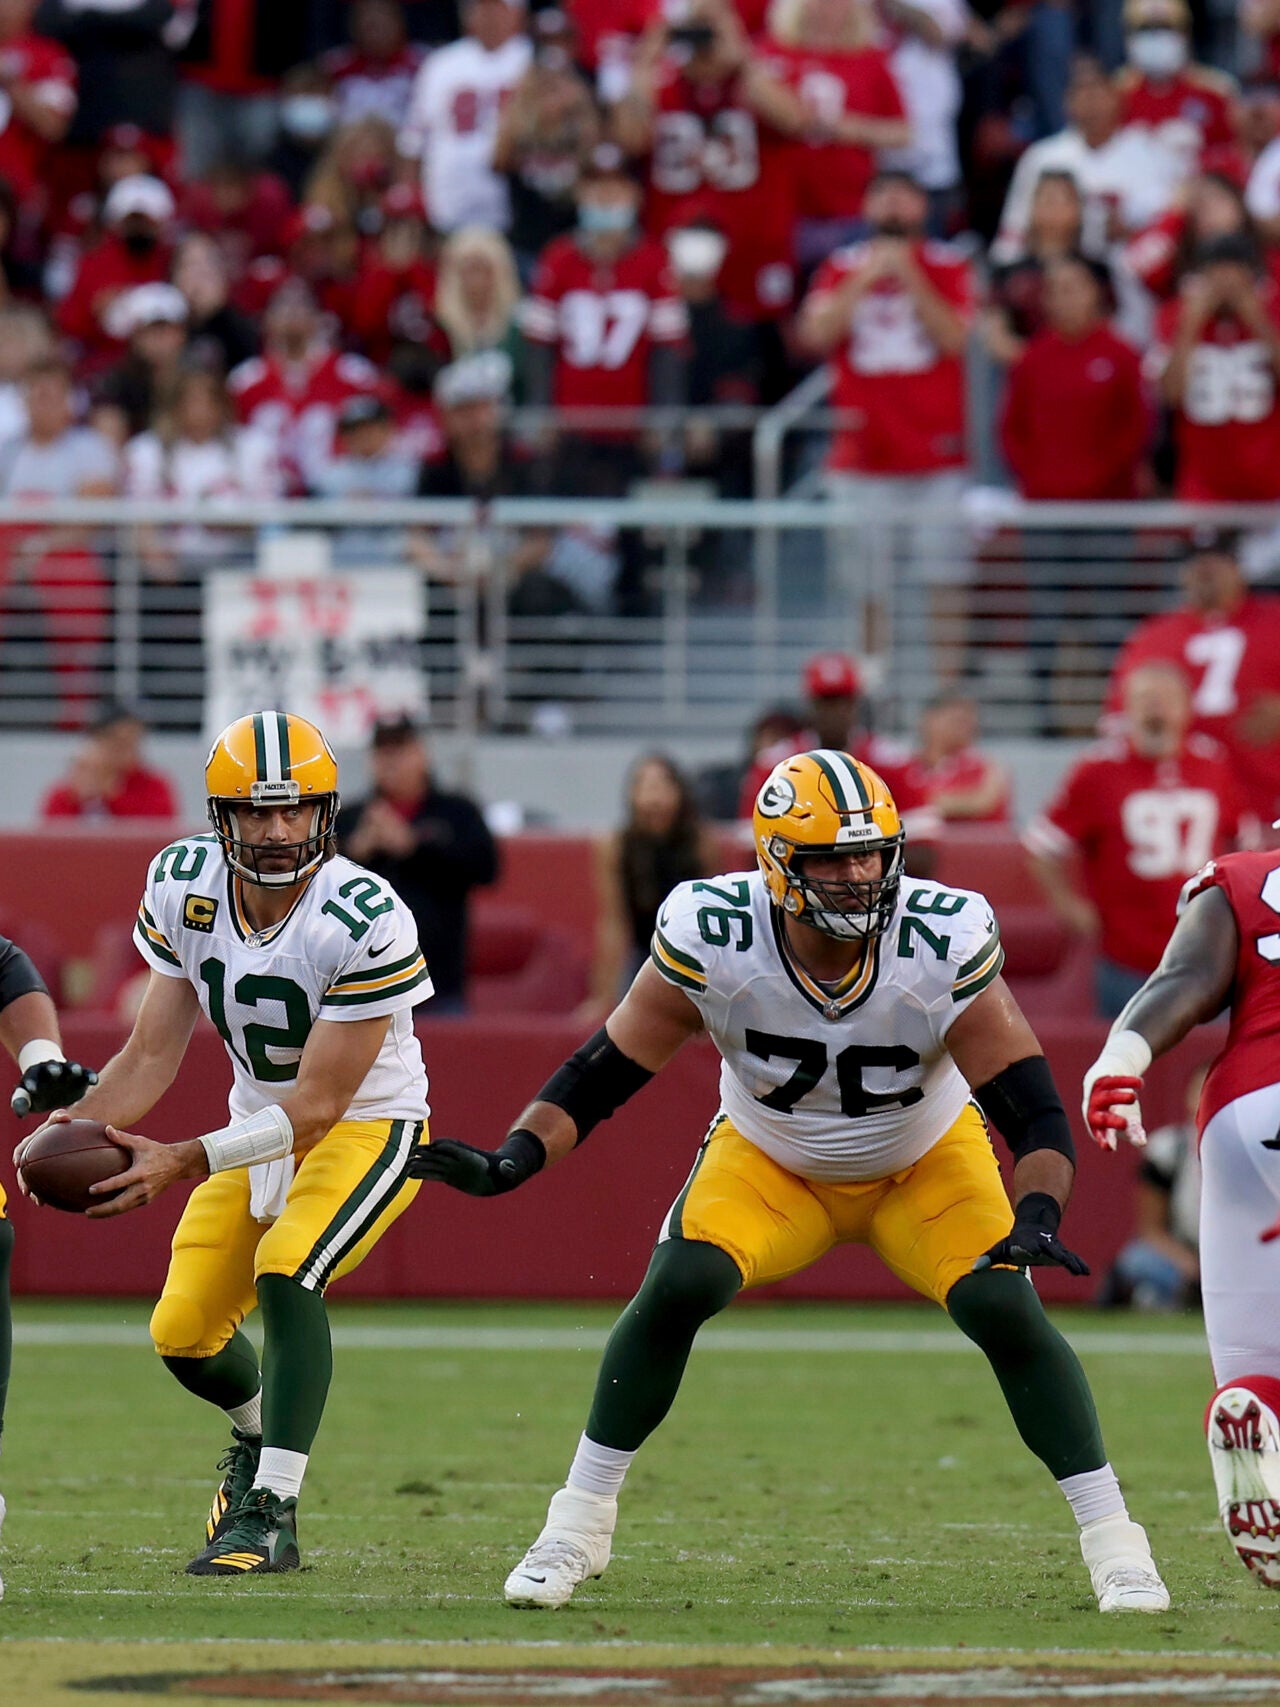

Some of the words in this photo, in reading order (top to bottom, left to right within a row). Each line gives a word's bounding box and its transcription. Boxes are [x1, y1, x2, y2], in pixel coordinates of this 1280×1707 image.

[1183, 626, 1247, 716] 7
[264, 783, 286, 791] PACKERS
[848, 829, 872, 838] PACKERS
[1122, 788, 1218, 880] 97
[186, 896, 214, 923] C
[321, 877, 395, 942] 12
[692, 880, 753, 952] 76
[897, 889, 969, 960] 76
[200, 957, 315, 1082] 12
[745, 1028, 925, 1118] 76
